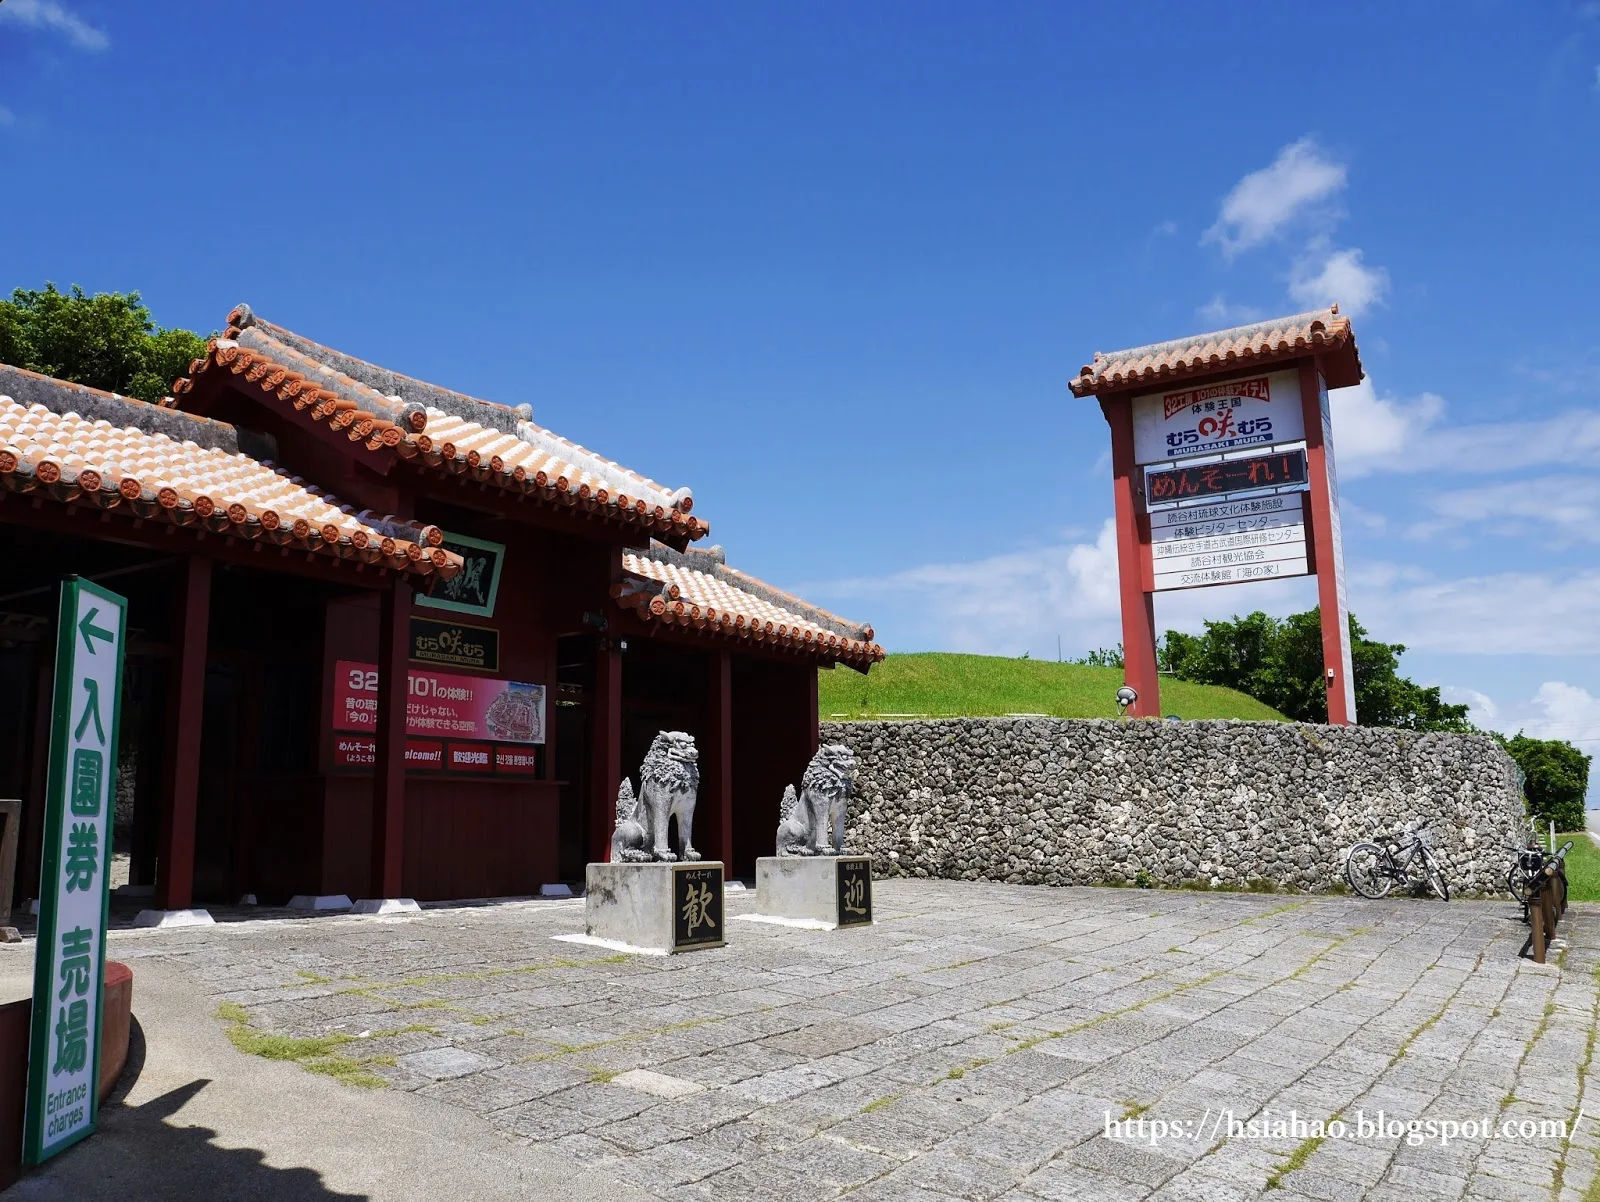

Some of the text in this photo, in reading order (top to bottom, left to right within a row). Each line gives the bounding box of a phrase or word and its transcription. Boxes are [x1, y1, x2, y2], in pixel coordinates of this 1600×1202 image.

[1191, 396, 1242, 415] 体験王国
[1166, 408, 1273, 447] むら咲むら
[1173, 434, 1267, 456] MURASAKI MURA
[1167, 498, 1284, 524] 読谷村琉球文化体験施設
[1174, 516, 1279, 539] 体験ビジターセンター
[1190, 549, 1265, 568] 読谷村観光協会
[415, 629, 485, 657] むら咲むら
[345, 697, 378, 711] 昔の琉
[406, 716, 479, 732] が体験できる空間。
[404, 749, 442, 761] elcome!!
[52, 676, 107, 1078] 入園券 売場
[844, 873, 867, 915] 迎
[47, 1082, 87, 1115] Entrance
[48, 1106, 83, 1137] charges
